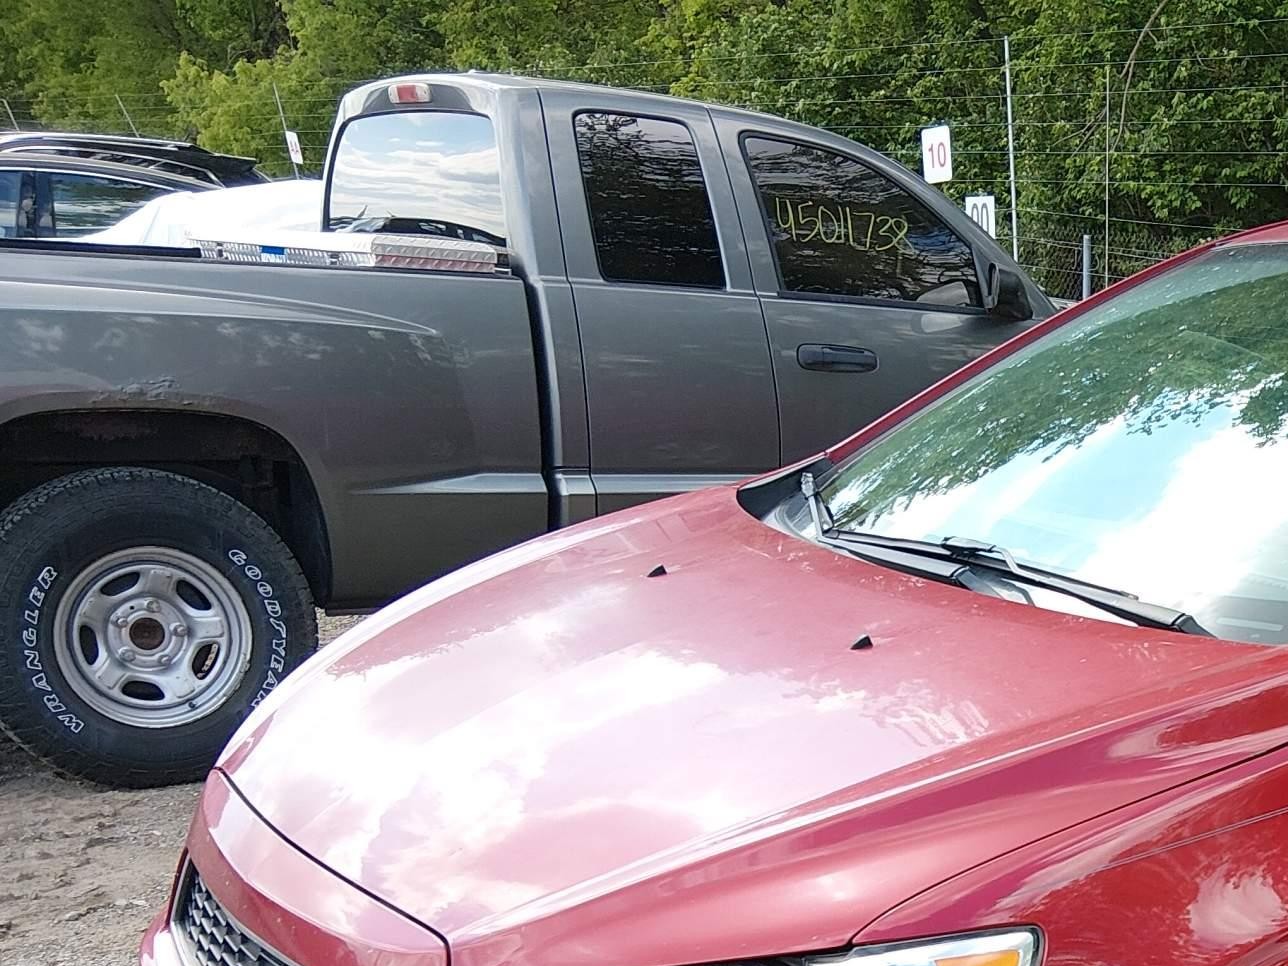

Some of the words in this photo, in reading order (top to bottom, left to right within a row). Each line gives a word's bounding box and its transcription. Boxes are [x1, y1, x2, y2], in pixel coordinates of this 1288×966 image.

[928, 142, 947, 169] 10
[776, 197, 915, 255] 45011738
[22, 566, 85, 734] WRANGLER
